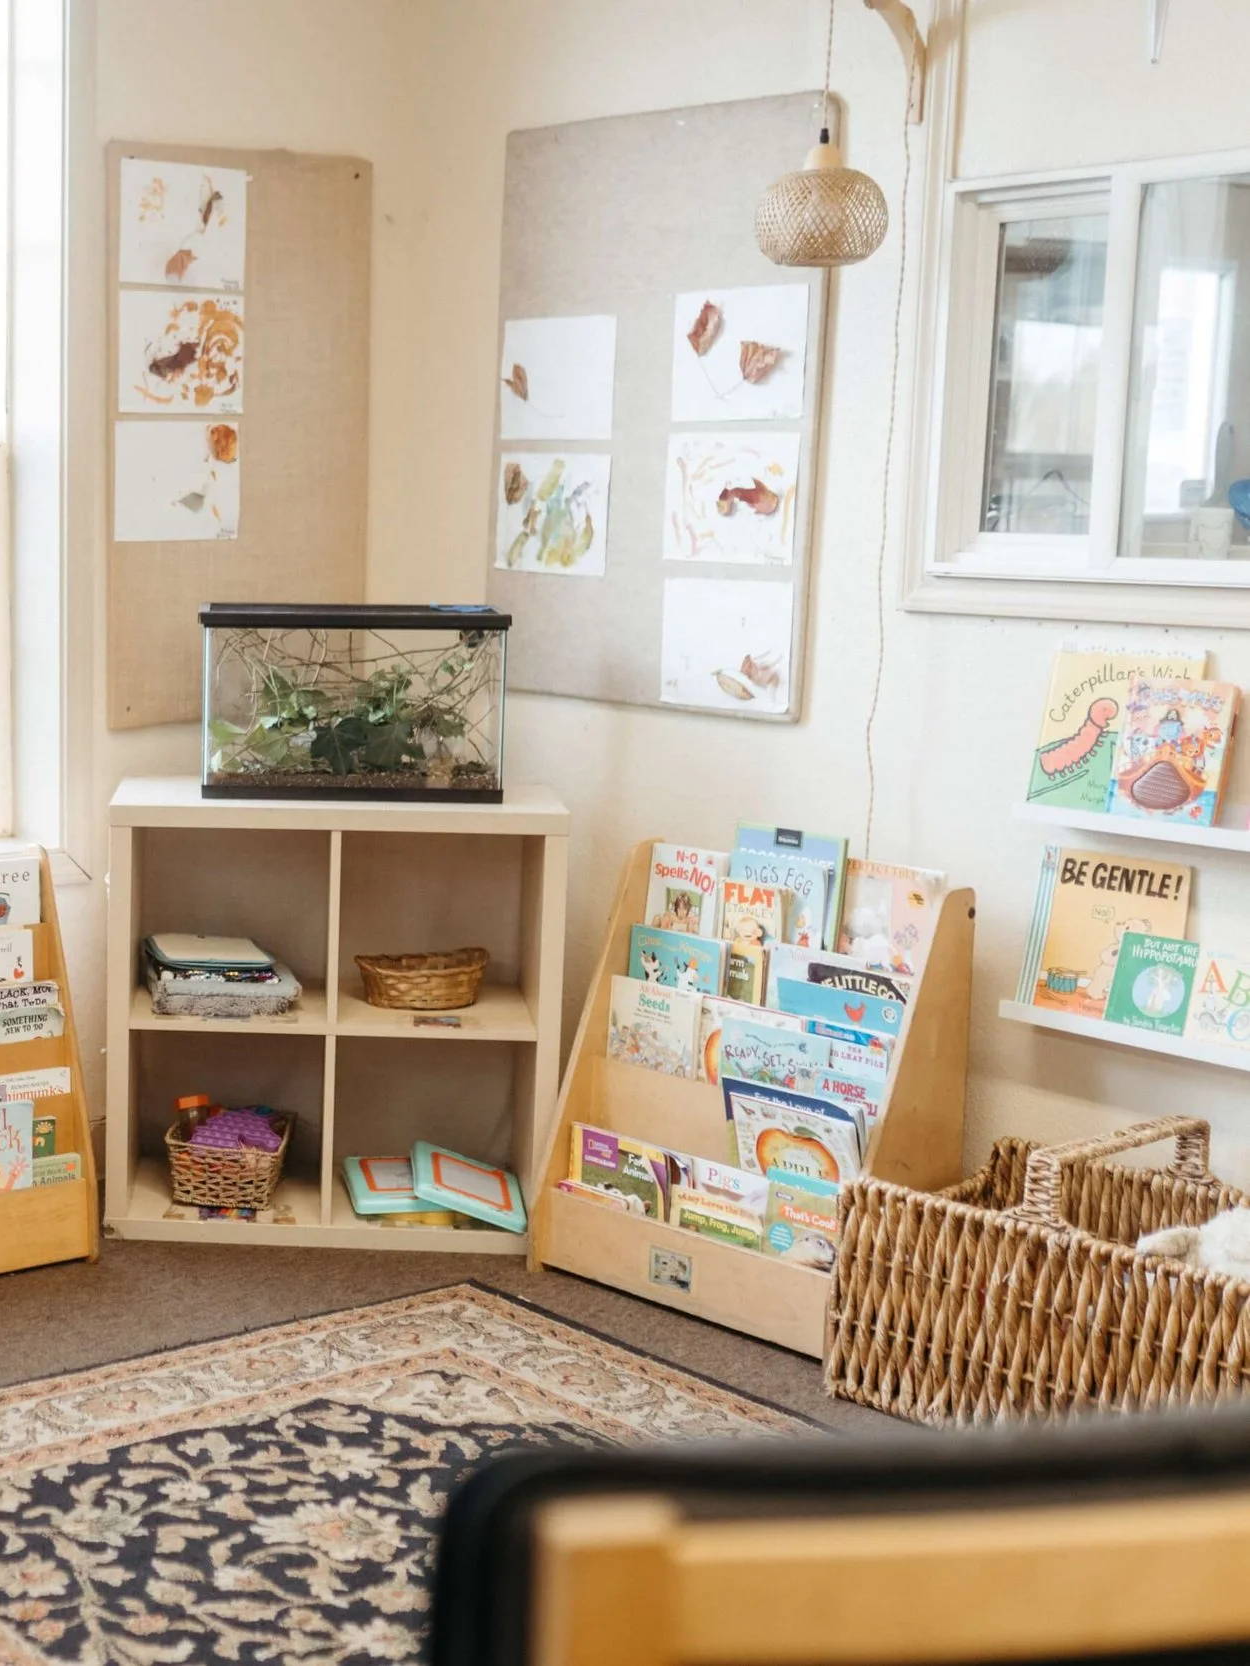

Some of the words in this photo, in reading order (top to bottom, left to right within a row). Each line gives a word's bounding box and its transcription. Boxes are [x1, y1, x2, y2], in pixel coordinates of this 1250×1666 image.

[676, 849, 698, 865] N-O
[654, 862, 689, 880] Spells
[689, 866, 716, 897] NO!
[783, 867, 813, 898] EGG
[1060, 857, 1090, 886] BE
[1091, 862, 1184, 901] GENTLE!
[724, 881, 775, 909] FLAT
[727, 902, 775, 919] STANLEY
[1131, 943, 1198, 968] HIPPOPOTAMU
[836, 974, 878, 995] LITTLE
[1199, 960, 1228, 993] A
[638, 992, 671, 1013] Seeds
[2, 1013, 48, 1028] SOMETHING
[22, 1024, 32, 1033] TO
[33, 1022, 44, 1031] DO
[724, 1043, 761, 1061] READY,
[762, 1051, 786, 1068] SET,
[821, 1078, 830, 1092] A
[832, 1080, 867, 1100] HORSE
[708, 1167, 742, 1191] Pigs
[683, 1210, 708, 1227] Jump,
[709, 1216, 730, 1234] Frog,
[783, 1205, 812, 1223] That's
